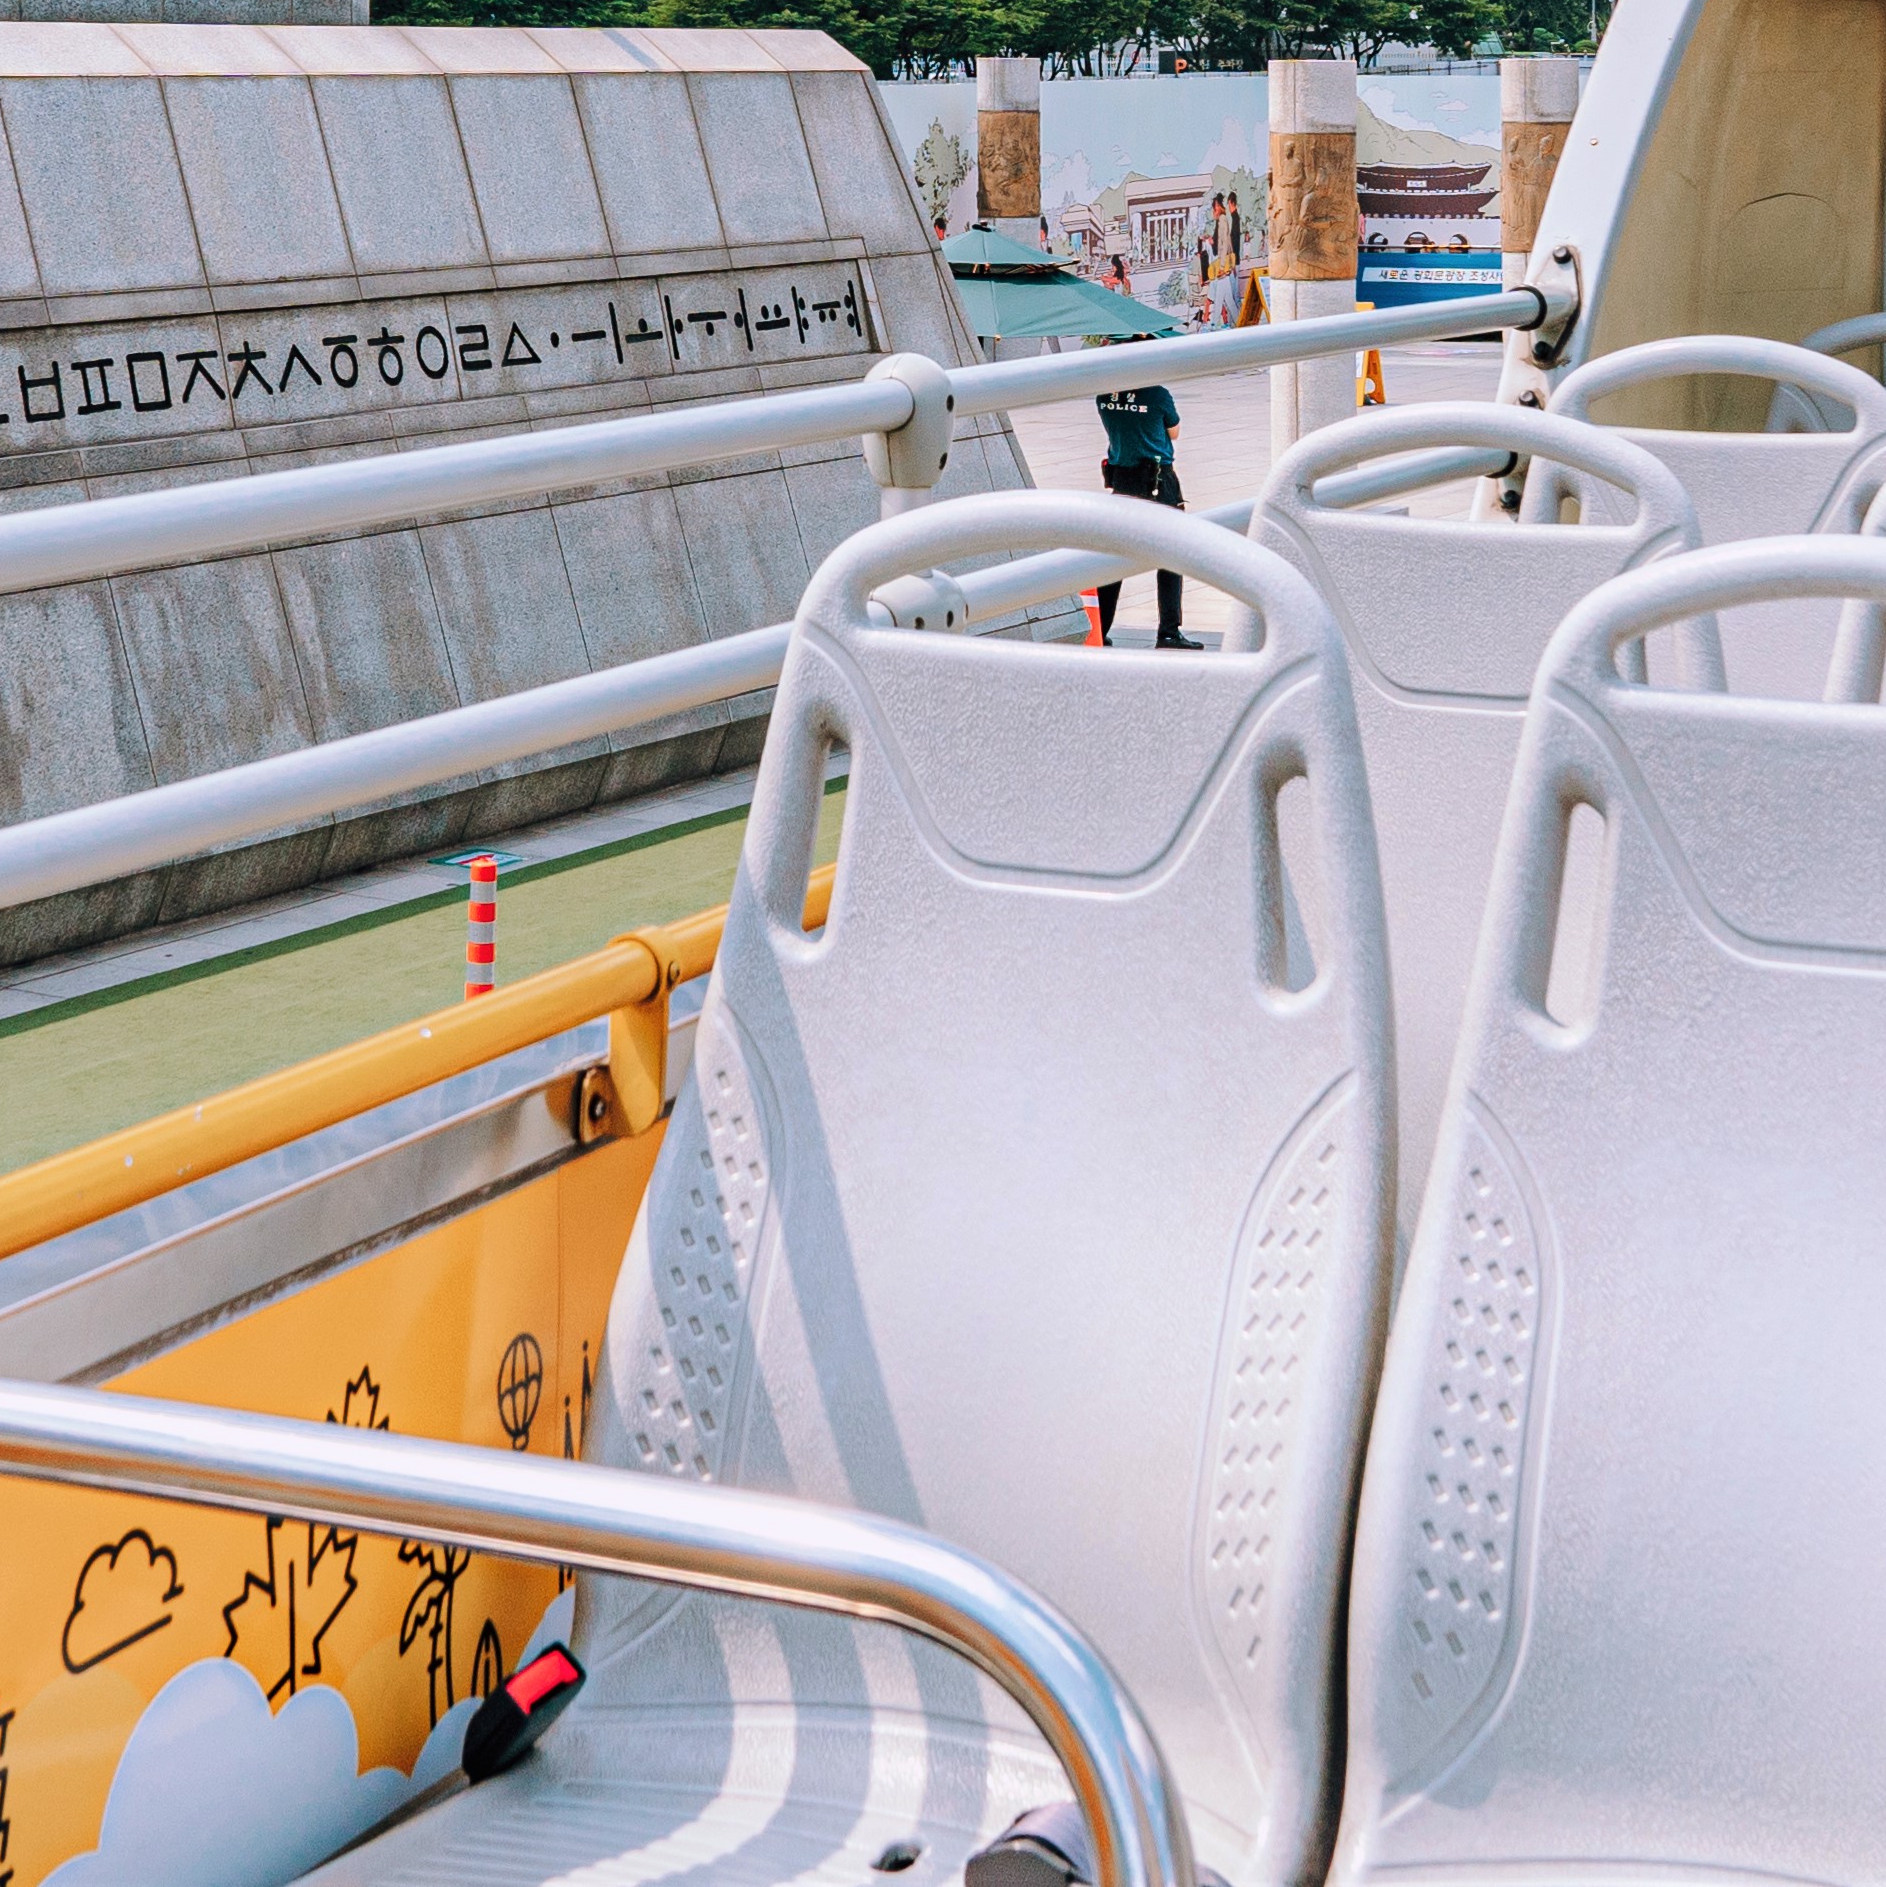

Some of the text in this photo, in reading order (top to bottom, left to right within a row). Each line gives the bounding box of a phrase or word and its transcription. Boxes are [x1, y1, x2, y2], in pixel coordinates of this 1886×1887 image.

[1378, 269, 1410, 281] 새로운
[1468, 270, 1504, 283] 조성사
[1099, 401, 1149, 413] POLICE
